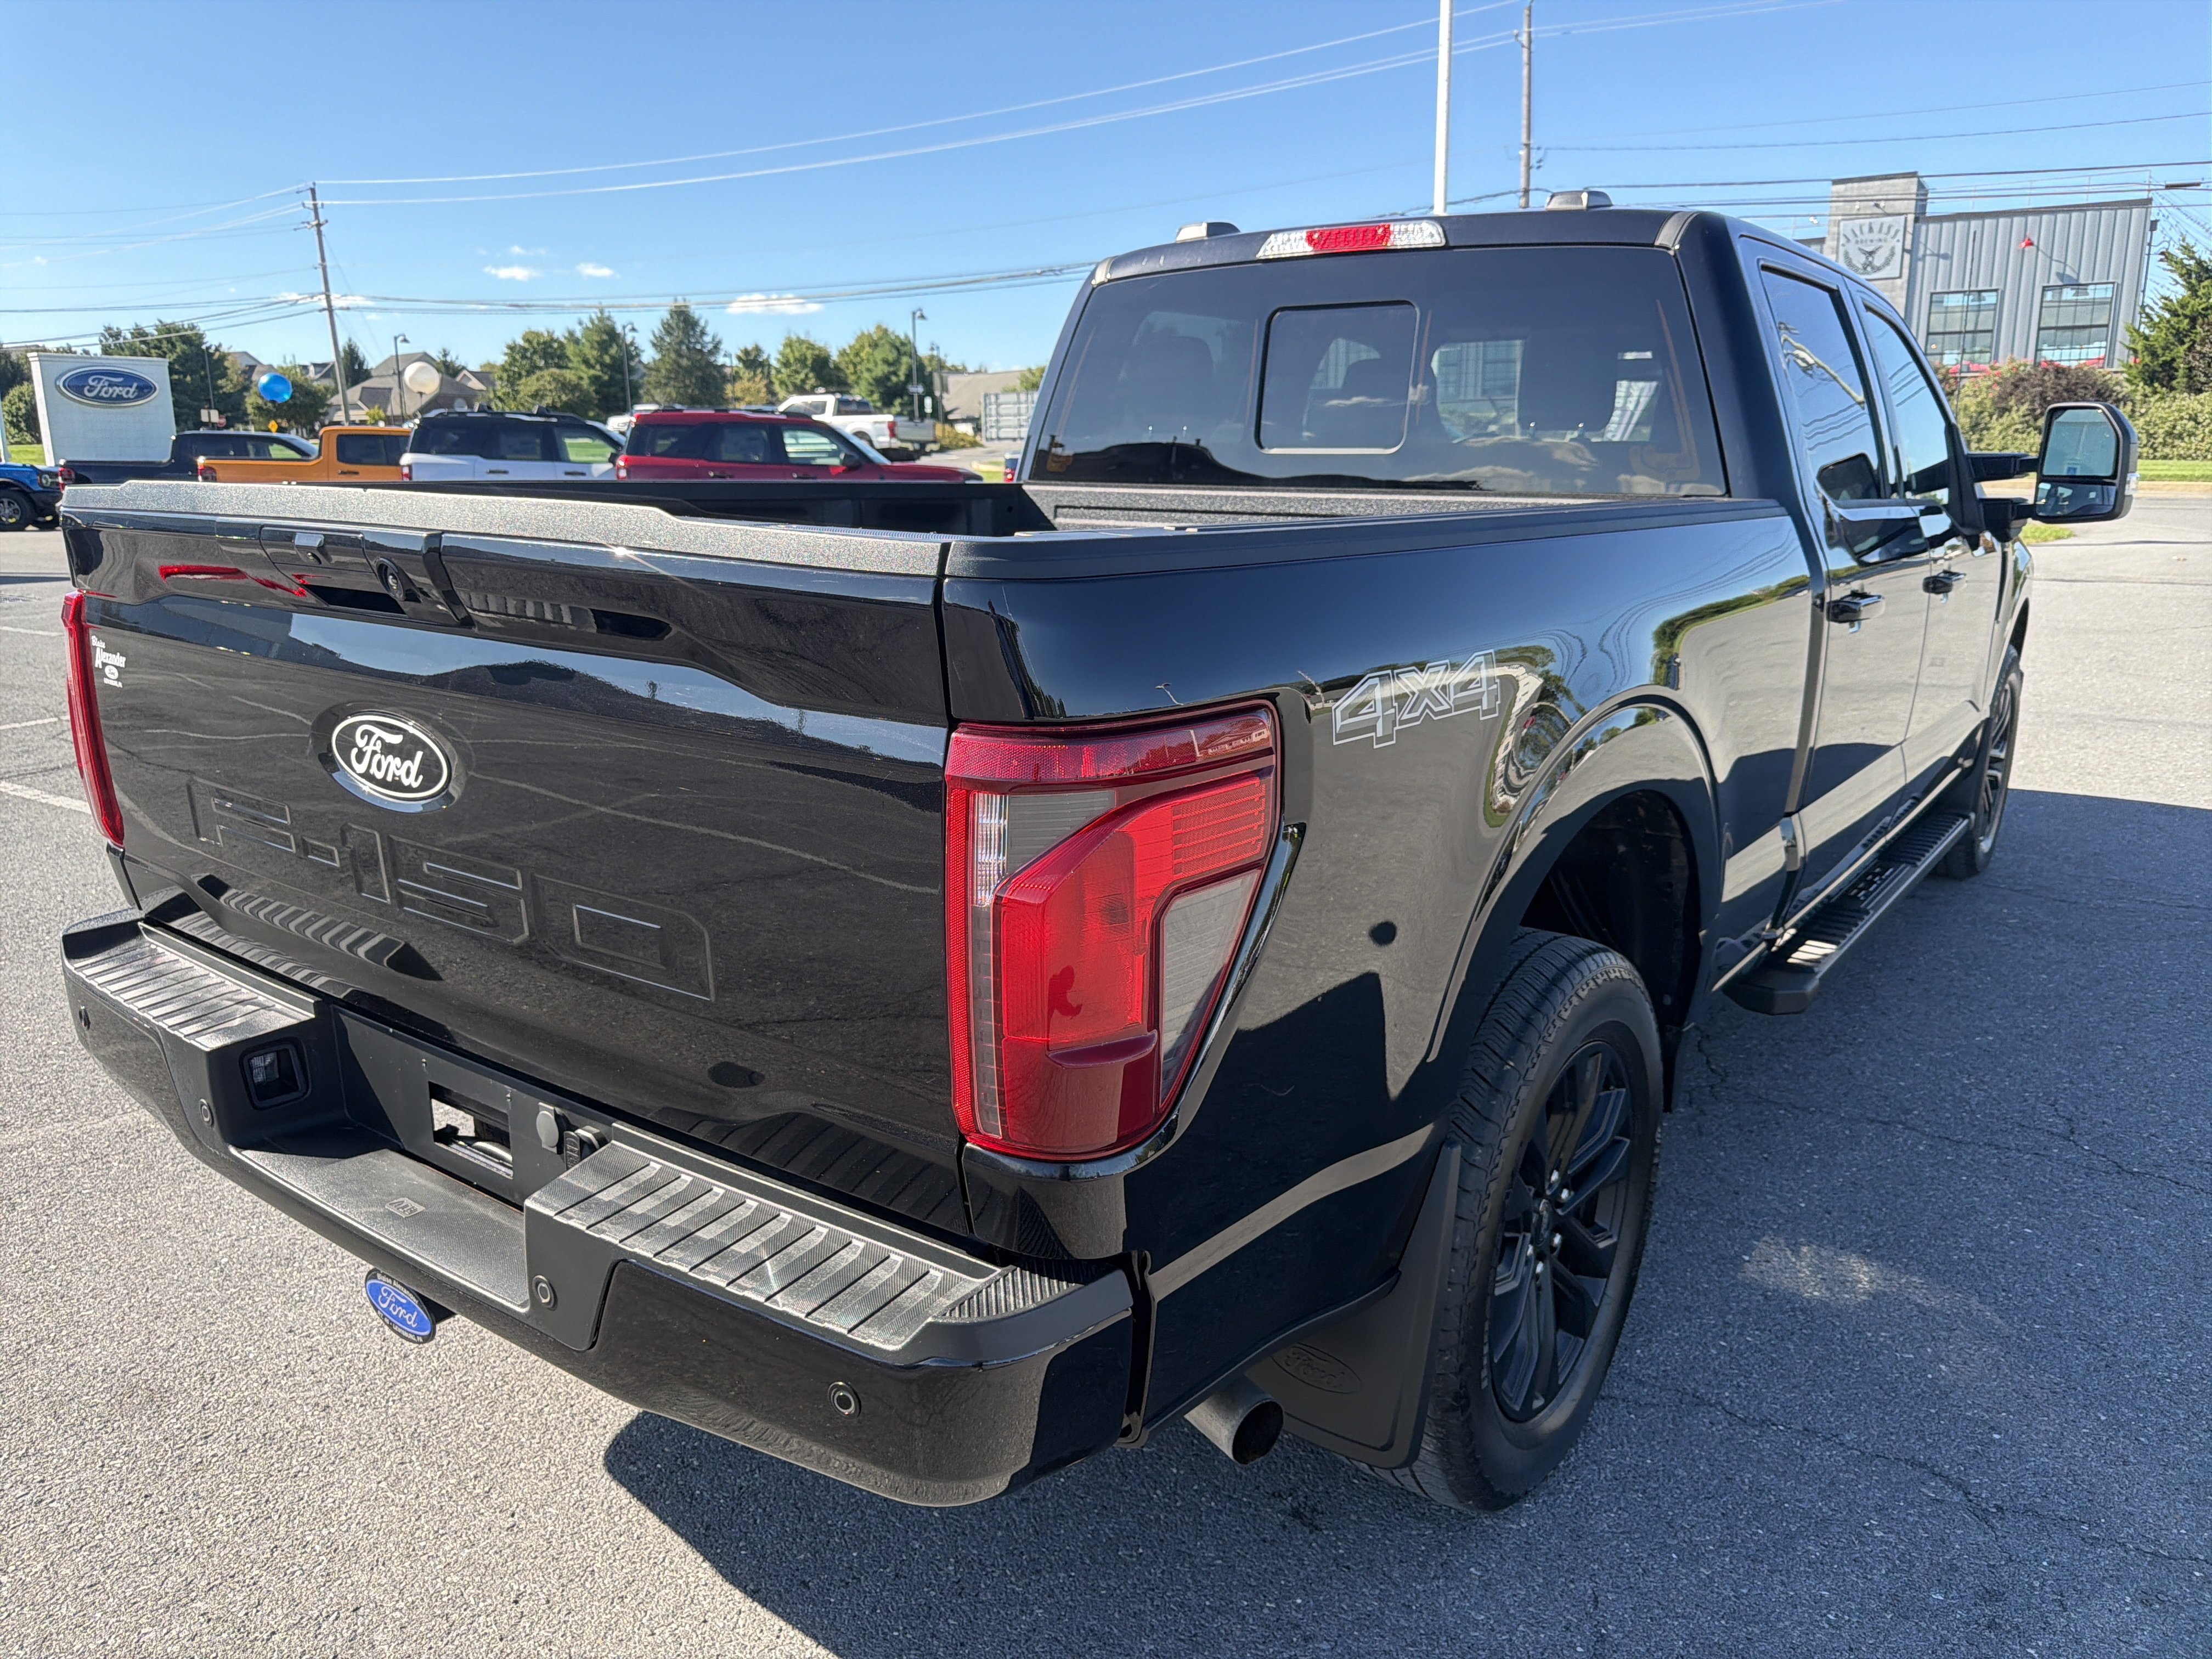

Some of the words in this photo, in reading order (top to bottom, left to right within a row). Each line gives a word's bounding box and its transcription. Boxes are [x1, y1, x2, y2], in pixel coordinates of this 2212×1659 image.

[84, 375, 138, 398] Ford
[95, 647, 126, 668] Alexander
[351, 724, 423, 788] Ford
[187, 777, 716, 1001] F-150
[379, 1286, 417, 1328] Ford
[393, 1280, 419, 1304] Alexander
